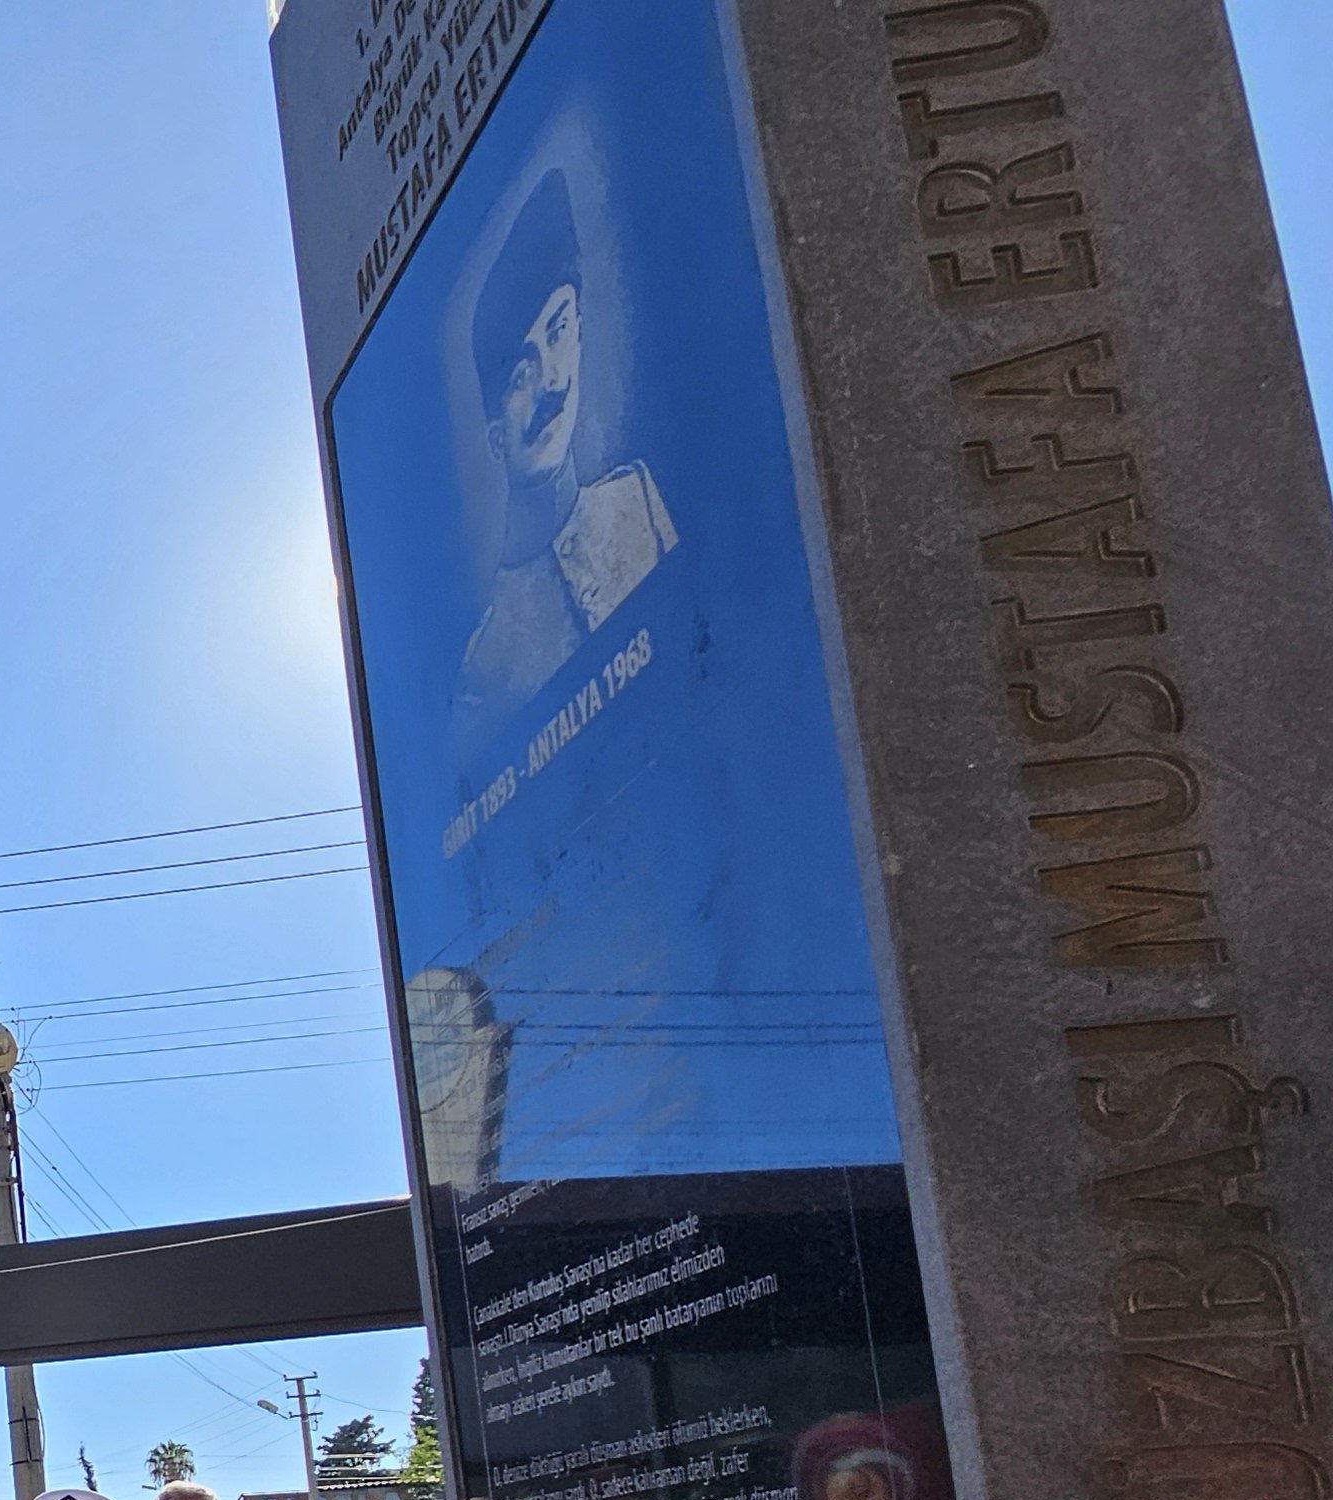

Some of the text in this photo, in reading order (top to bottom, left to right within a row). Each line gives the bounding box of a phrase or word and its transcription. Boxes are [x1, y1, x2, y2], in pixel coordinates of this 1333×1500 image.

[338, 35, 393, 162] Antalya
[374, 33, 421, 146] Büyük
[386, 60, 441, 175] Topçu
[357, 112, 452, 315] MUSTAFA
[949, 331, 1231, 968] MUSTAFA
[479, 765, 517, 823] 1893
[528, 678, 603, 778] ANTALYA
[603, 628, 652, 699] 1968
[527, 1272, 564, 1300] Kurtuluş
[563, 1255, 607, 1287] Savaşı'na
[605, 1239, 634, 1270] kadar
[635, 1233, 653, 1257] her
[654, 1210, 700, 1250] cephede
[580, 1288, 611, 1323] yenilip
[612, 1267, 671, 1305] silahlarımız
[670, 1244, 725, 1284] elimizden
[593, 1330, 607, 1352] bir
[607, 1322, 624, 1348] tek
[625, 1320, 639, 1341] bu
[639, 1308, 664, 1343] şanlı
[664, 1291, 726, 1329] bataryanın
[726, 1273, 779, 1310] toplarını
[633, 1464, 686, 1493] kahraman
[687, 1451, 719, 1485] değil,
[720, 1446, 749, 1477] zafer
[708, 1403, 772, 1437] beklerken,
